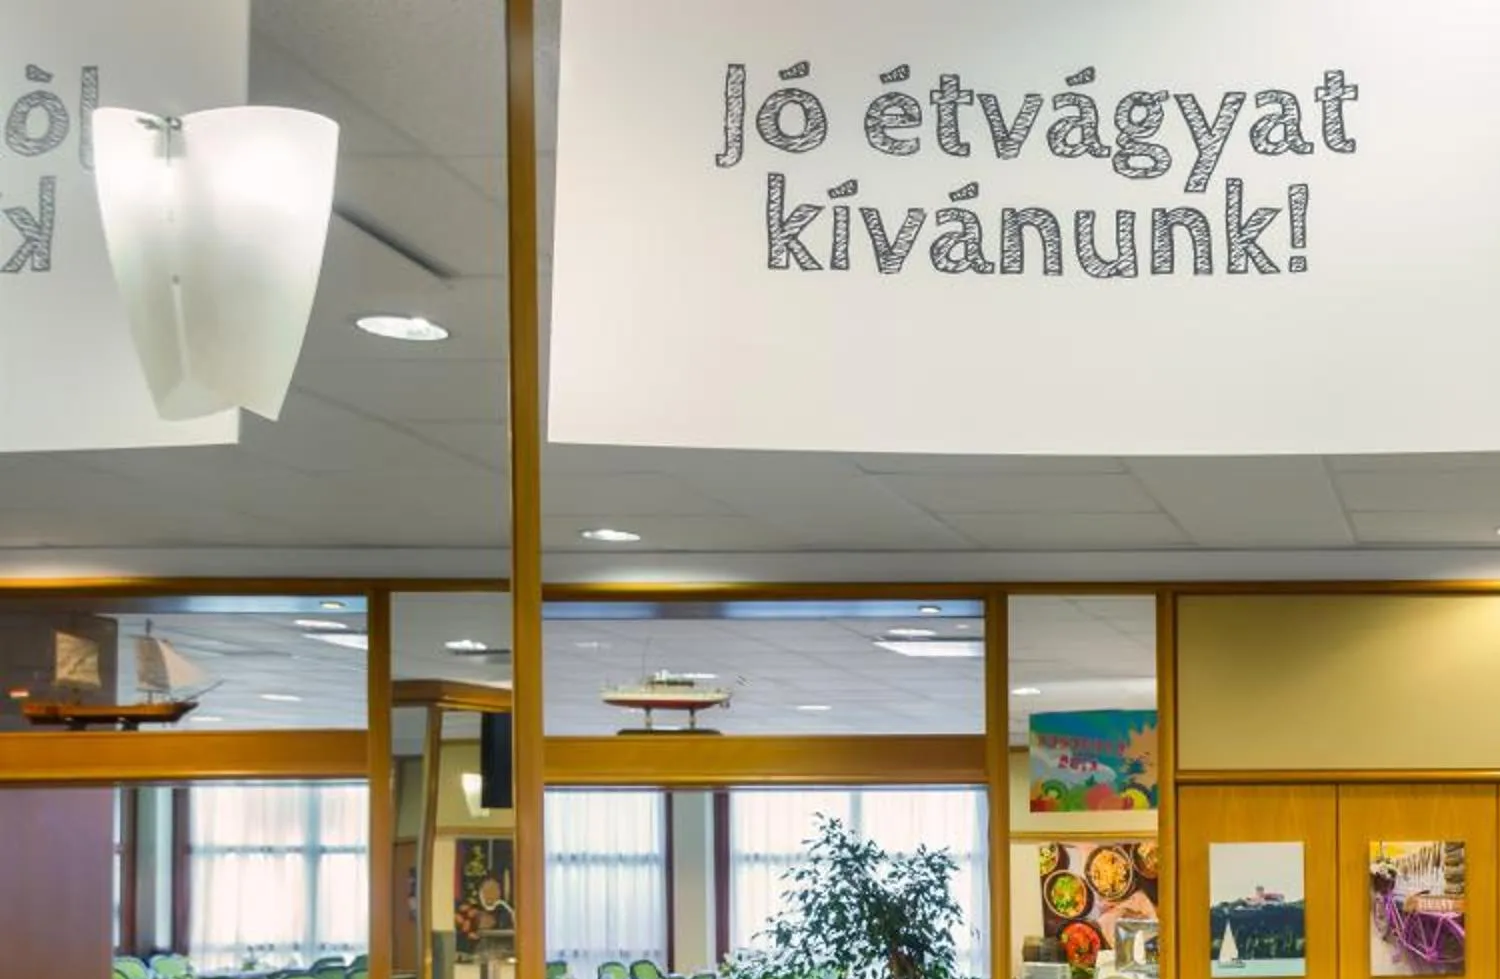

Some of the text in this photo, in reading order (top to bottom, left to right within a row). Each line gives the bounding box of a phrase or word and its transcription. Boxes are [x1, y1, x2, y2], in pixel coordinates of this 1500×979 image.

[716, 61, 1358, 192] Jó étvágyat
[767, 173, 1308, 277] kívánunk!
